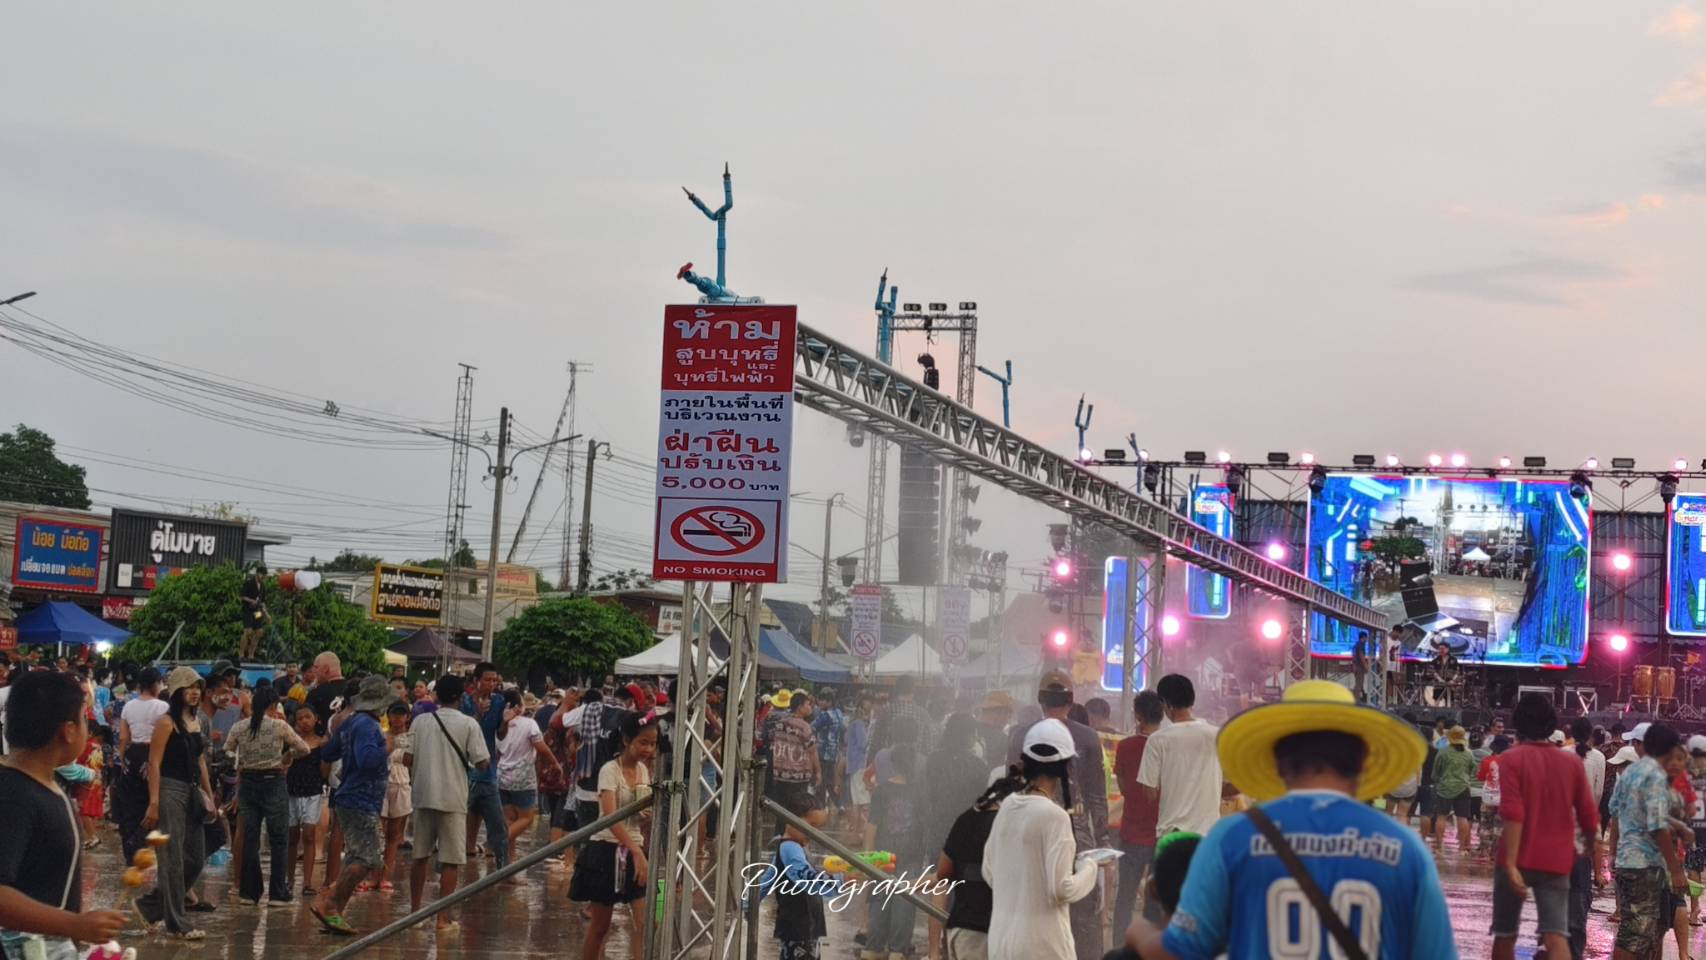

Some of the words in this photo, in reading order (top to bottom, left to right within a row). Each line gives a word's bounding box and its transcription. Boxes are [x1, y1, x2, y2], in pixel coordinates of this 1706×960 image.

[672, 308, 781, 340] ห้าม
[675, 341, 779, 366] สูบบุหรี่
[673, 367, 775, 386] บุหรี่ไฟฟ้า
[664, 393, 784, 409] ภายในพื้นที่
[664, 408, 781, 422] บริเวณงาน
[664, 428, 780, 453] ฝ่าฝืน
[660, 453, 781, 471] ปรับเงิน
[661, 476, 746, 490] 5,000
[749, 483, 780, 491] บาท
[31, 525, 56, 548] น้อย
[61, 528, 90, 552] มือถือ
[663, 566, 686, 574] NO
[692, 567, 766, 577] SMOKING
